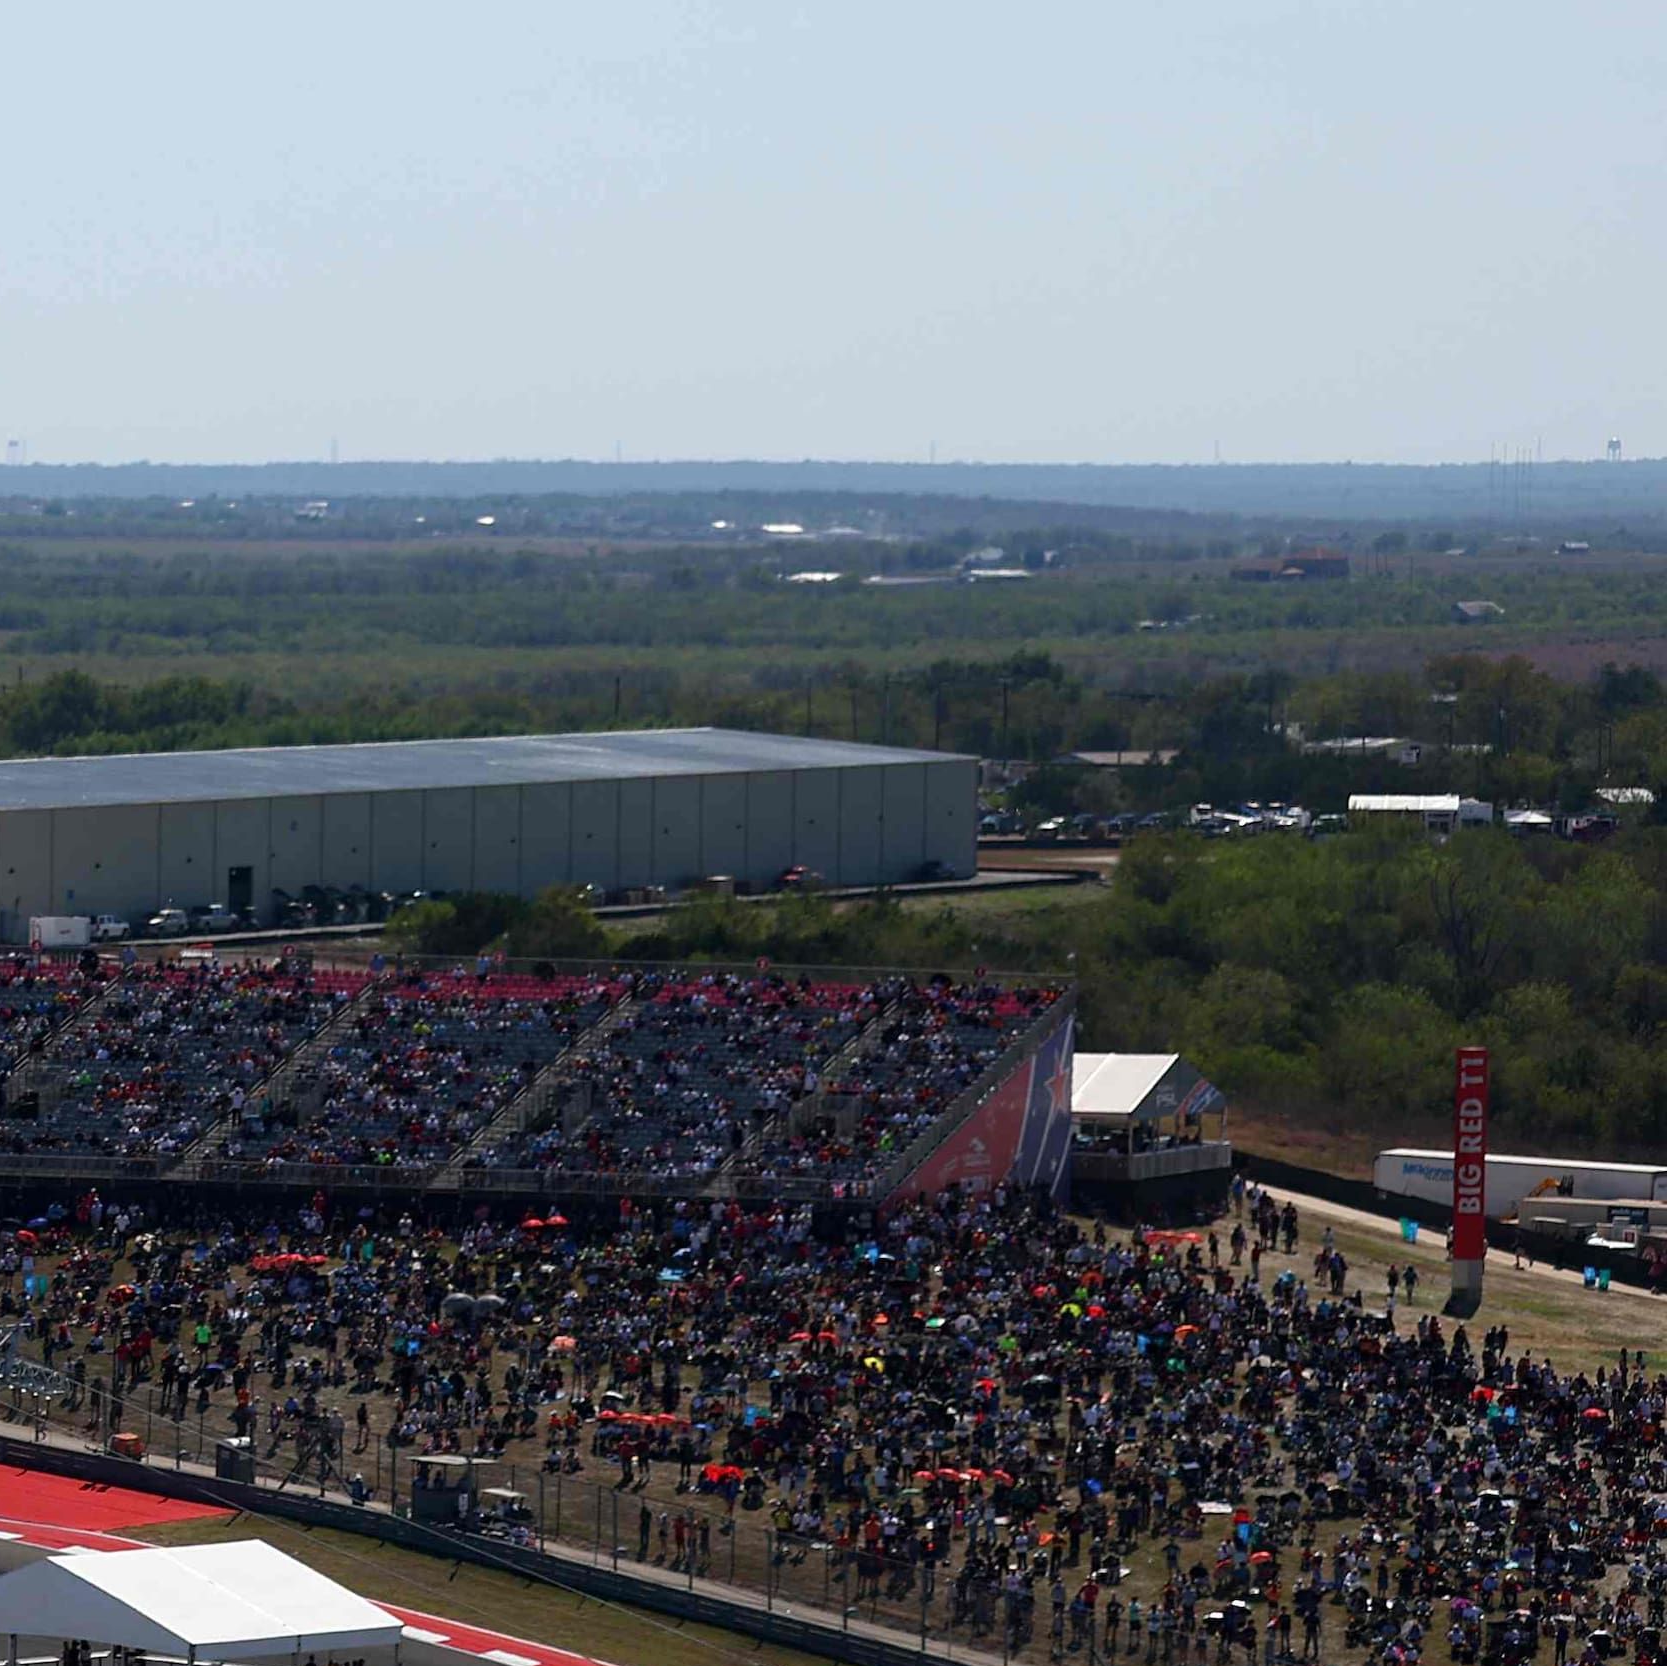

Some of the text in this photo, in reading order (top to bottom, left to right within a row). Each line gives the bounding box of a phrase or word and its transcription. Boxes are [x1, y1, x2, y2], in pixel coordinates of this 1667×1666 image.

[1458, 1058, 1484, 1214] BIG RED T1
